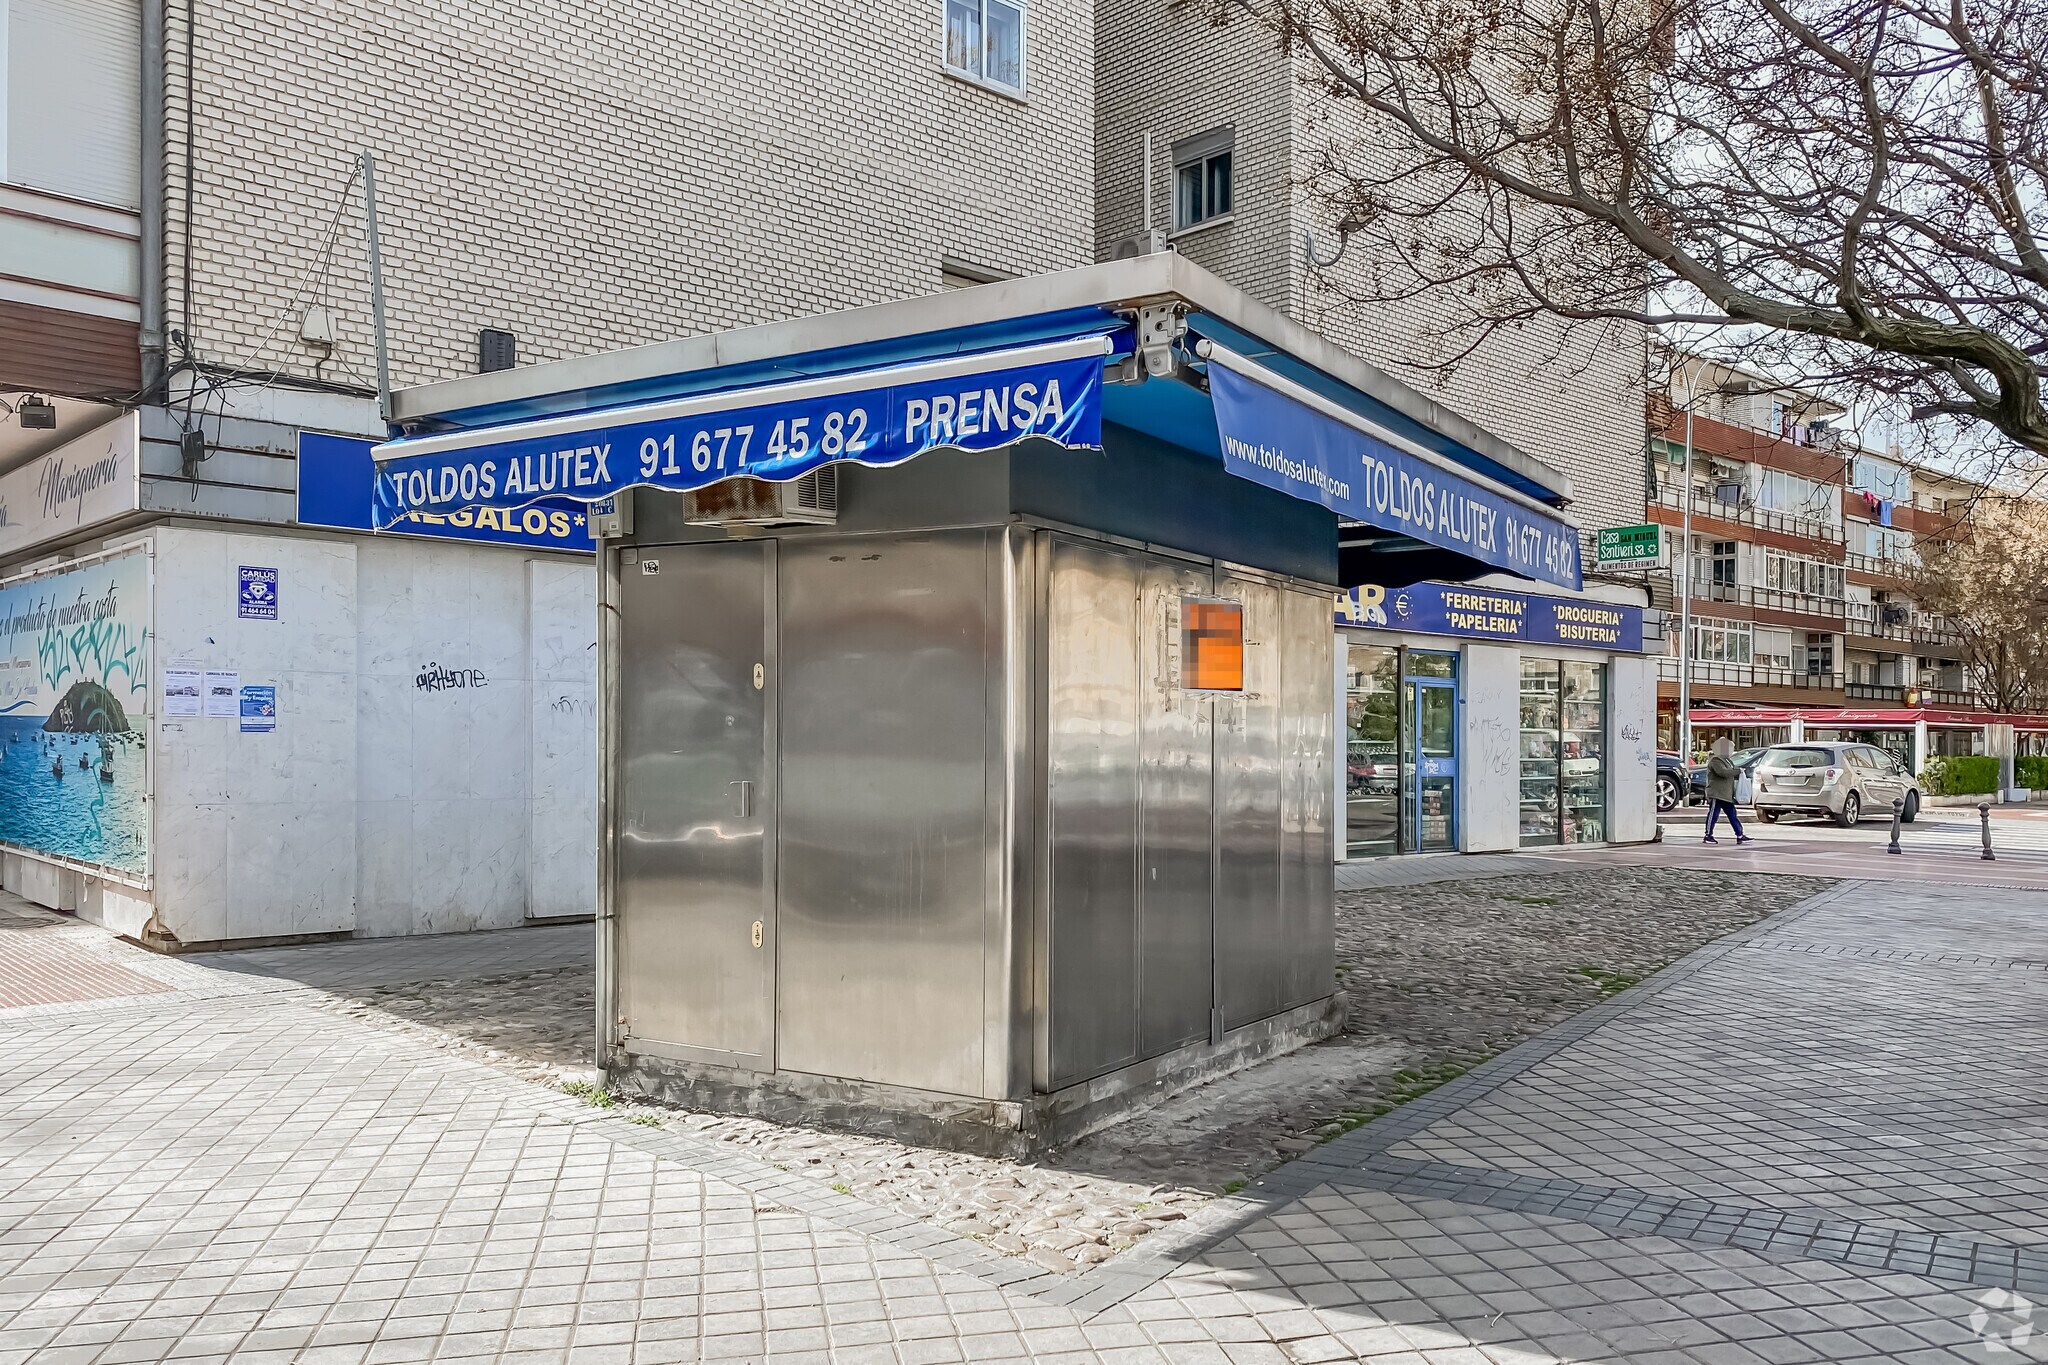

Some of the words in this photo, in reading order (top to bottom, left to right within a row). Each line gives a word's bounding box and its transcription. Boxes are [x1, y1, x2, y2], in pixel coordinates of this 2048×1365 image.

[393, 460, 497, 508] TOLDOS
[504, 443, 612, 495] ALUTEX
[640, 434, 681, 478] 91
[691, 425, 755, 471] 677
[767, 417, 810, 462] 45
[822, 408, 868, 456] 82
[904, 379, 1064, 444] PRENSA
[1225, 435, 1350, 501] www.toldosalutex.com
[38, 442, 117, 525] Marisquería
[1362, 454, 1435, 532] TOLDOS
[1438, 488, 1498, 553] ALUTEX
[1506, 516, 1518, 560] 91
[1521, 524, 1542, 568] 677
[1545, 534, 1559, 575] 45
[1560, 540, 1574, 580] 82
[1600, 543, 1634, 559] Santiveri
[1601, 531, 1620, 544] Casa
[1621, 534, 1632, 543] SAN
[1634, 532, 1657, 541] MIGUEL
[1601, 562, 1627, 570] ALIMENTOS
[1635, 560, 1656, 568] REGIMEN
[10, 598, 47, 654] producto
[46, 593, 58, 629] de
[58, 587, 90, 627] nuestra
[93, 579, 119, 621] costa
